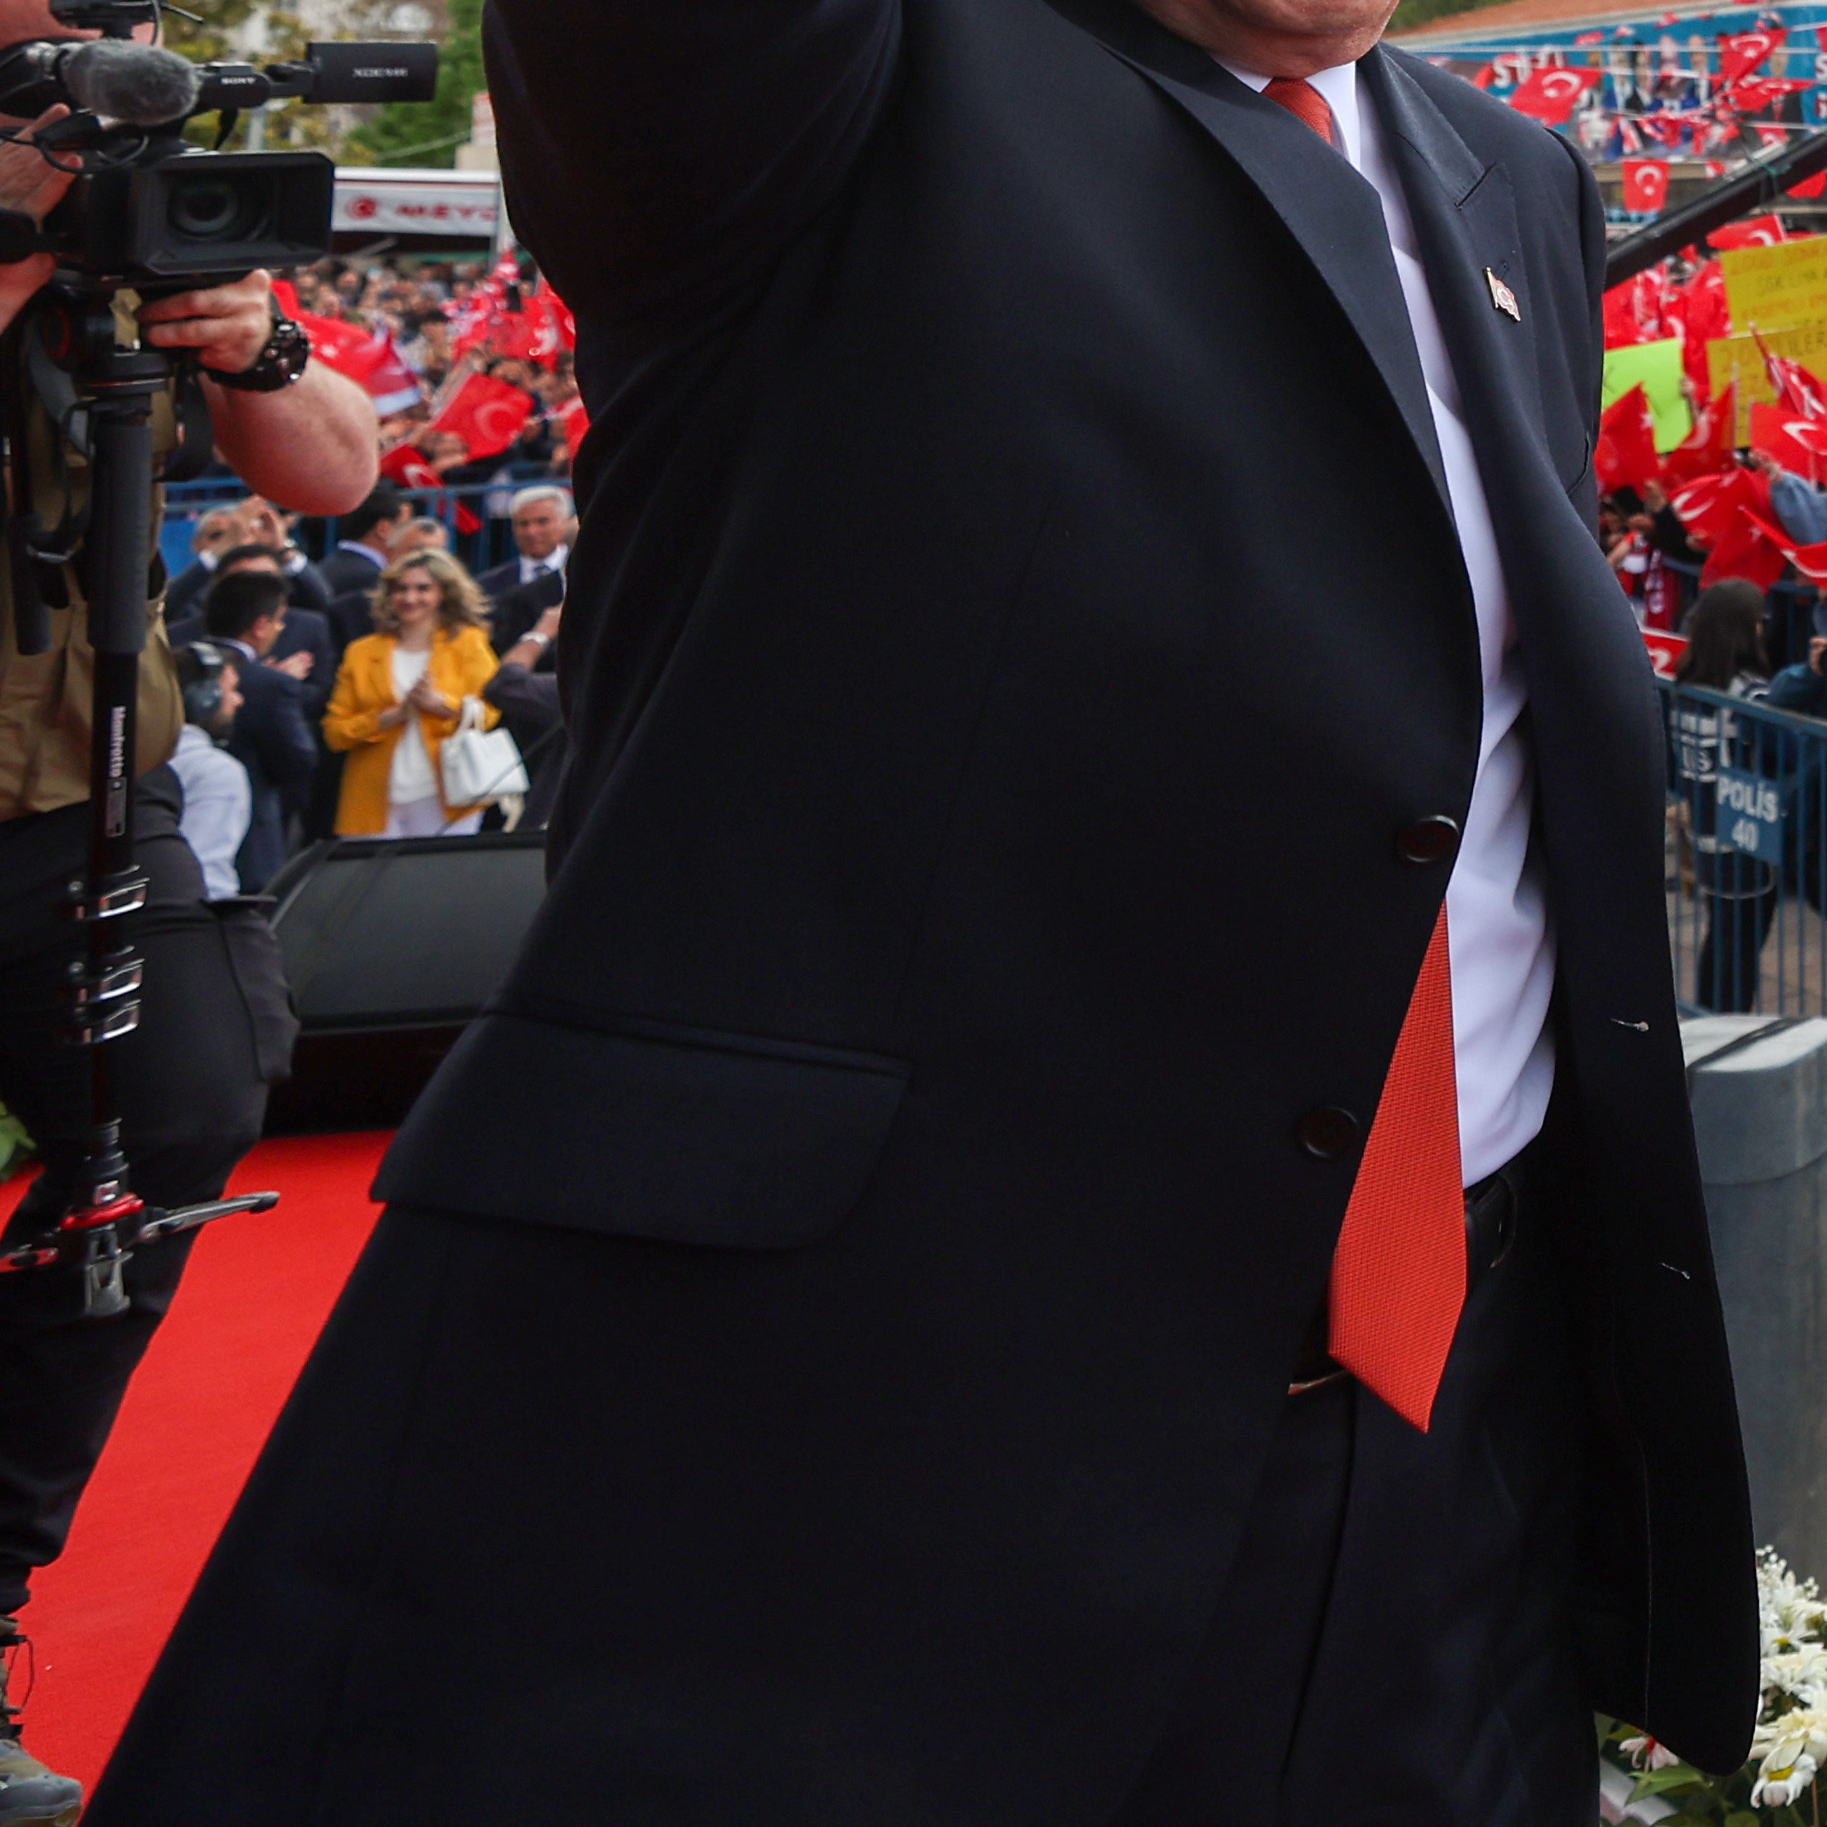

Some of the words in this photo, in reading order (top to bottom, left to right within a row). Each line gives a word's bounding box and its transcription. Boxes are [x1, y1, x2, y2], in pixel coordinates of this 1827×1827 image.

[221, 76, 257, 85] SONY
[109, 705, 126, 778] Manfrotto
[1717, 775, 1780, 823] POLİS
[1731, 818, 1760, 853] 40
